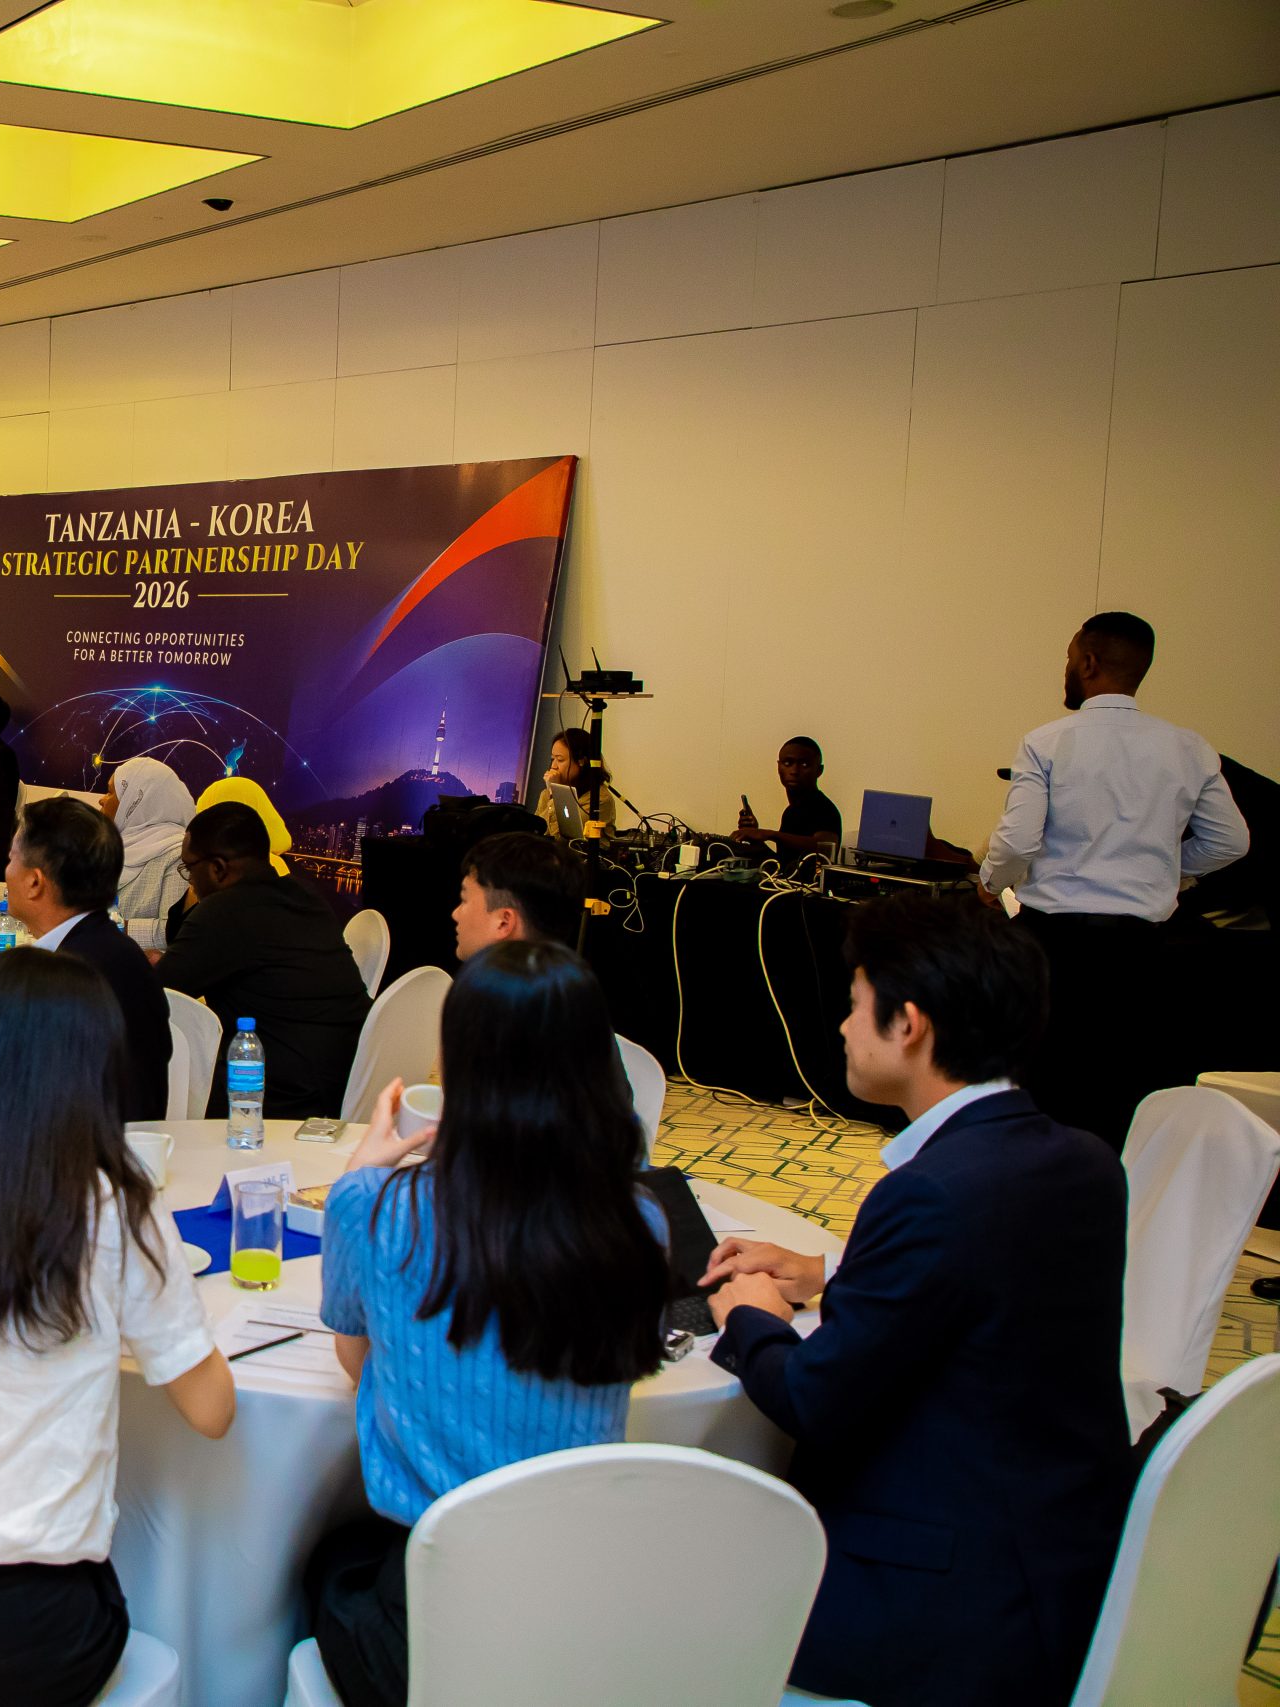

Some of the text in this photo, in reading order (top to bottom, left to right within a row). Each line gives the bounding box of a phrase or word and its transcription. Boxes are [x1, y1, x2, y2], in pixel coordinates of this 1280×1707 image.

[45, 507, 182, 543] TANZANIA
[208, 499, 315, 537] KOREA
[1, 541, 366, 577] STRATEGIC PARTNERSHIP DAY
[133, 579, 190, 609] 2026
[66, 630, 246, 648] CONNECTING OPPORTUNITIES
[73, 648, 233, 666] FOR A BETTER TOMORROW
